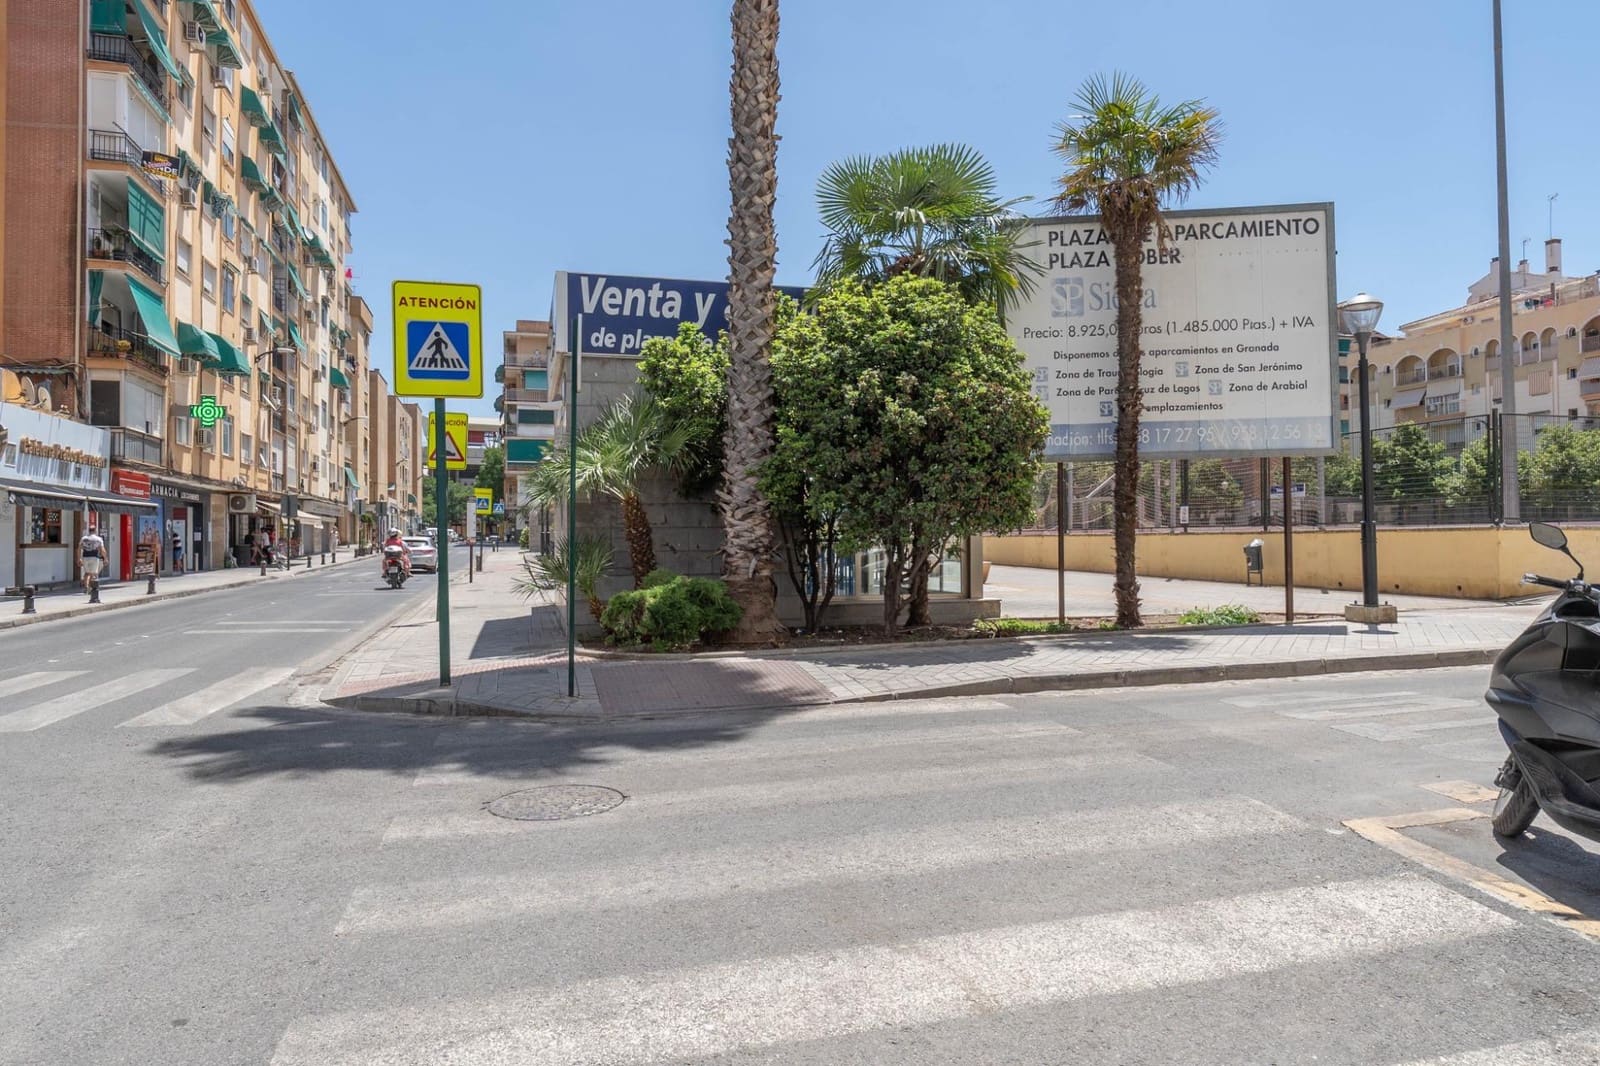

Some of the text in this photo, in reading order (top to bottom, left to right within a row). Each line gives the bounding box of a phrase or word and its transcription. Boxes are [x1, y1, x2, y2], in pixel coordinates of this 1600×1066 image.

[1049, 250, 1110, 270] PLAZA
[398, 296, 476, 310] ATENCIÓN
[580, 276, 682, 319] Venta
[694, 292, 717, 329] y
[1023, 325, 1064, 339] Precio:
[1166, 318, 1239, 335] (1.485.000
[1292, 316, 1315, 328] IVA
[590, 327, 617, 348] de
[1053, 351, 1110, 361] Disponemos
[1148, 345, 1218, 358] aparcamientos
[1221, 346, 1233, 354] en
[1236, 342, 1279, 353] Granada
[1056, 370, 1080, 379] Zona
[1083, 369, 1095, 378] de
[1194, 365, 1219, 374] Zona
[1222, 364, 1235, 373] de
[1238, 363, 1255, 372] San
[1259, 361, 1303, 372] Jerónimo
[1056, 388, 1081, 397] Zona
[1084, 387, 1096, 396] de
[1158, 384, 1170, 393] de
[1173, 384, 1201, 395] Lagos
[1229, 383, 1254, 392] Zona
[1256, 382, 1269, 391] de
[1271, 380, 1308, 390] Arabial
[1145, 402, 1223, 413] emplazamientos
[1156, 428, 1171, 442] 17
[1175, 427, 1193, 442] 27
[1196, 426, 1214, 441] 95
[1284, 423, 1300, 438] 56
